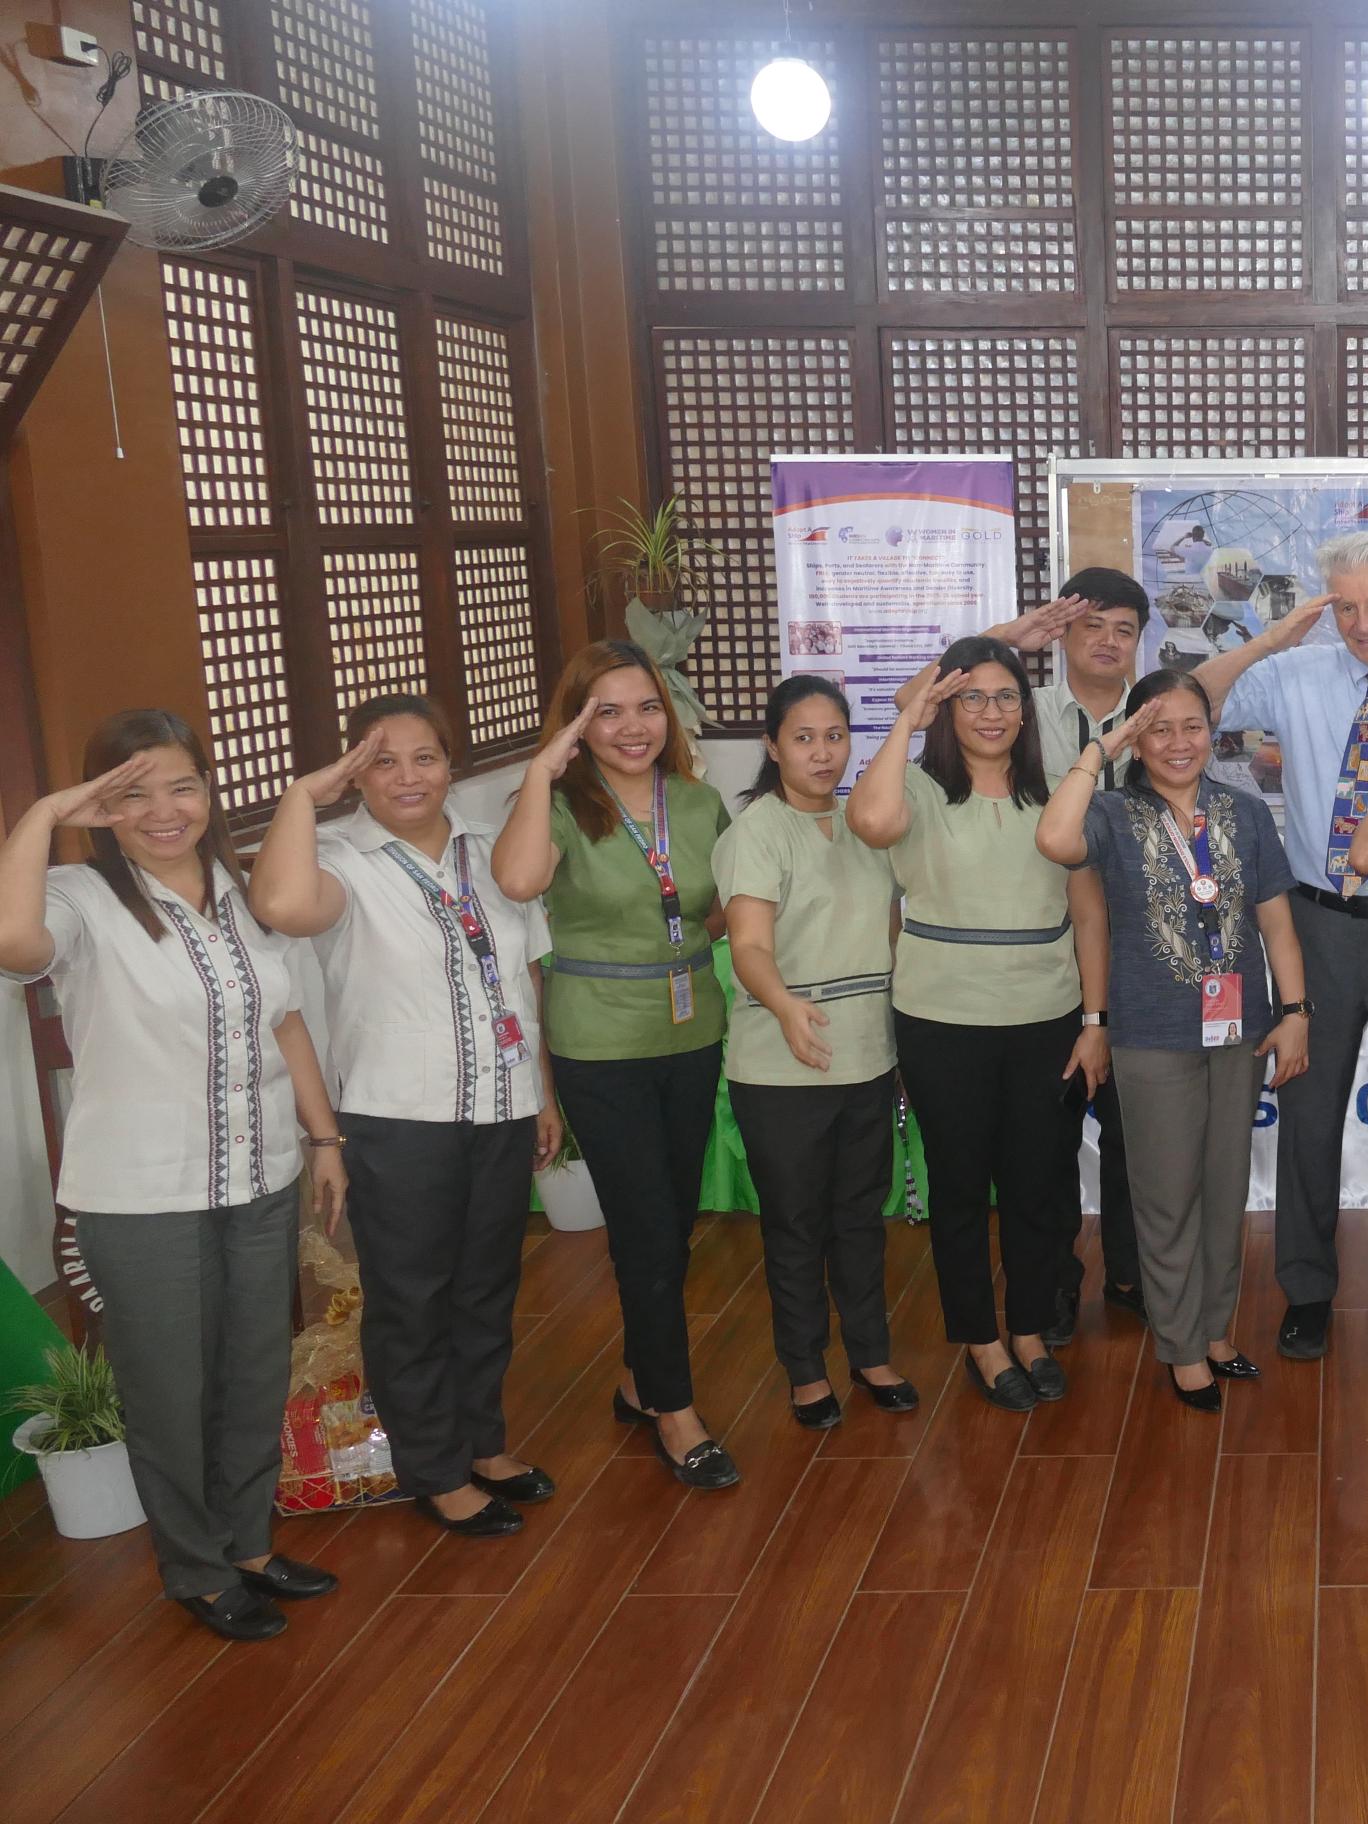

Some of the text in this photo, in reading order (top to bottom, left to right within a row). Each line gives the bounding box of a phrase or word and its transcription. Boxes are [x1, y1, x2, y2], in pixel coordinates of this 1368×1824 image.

[961, 531, 1002, 541] GOLD
[406, 863, 415, 871] OF
[412, 868, 425, 879] SAN
[424, 878, 440, 892] PEDRO
[60, 1216, 105, 1313] PAARALA
